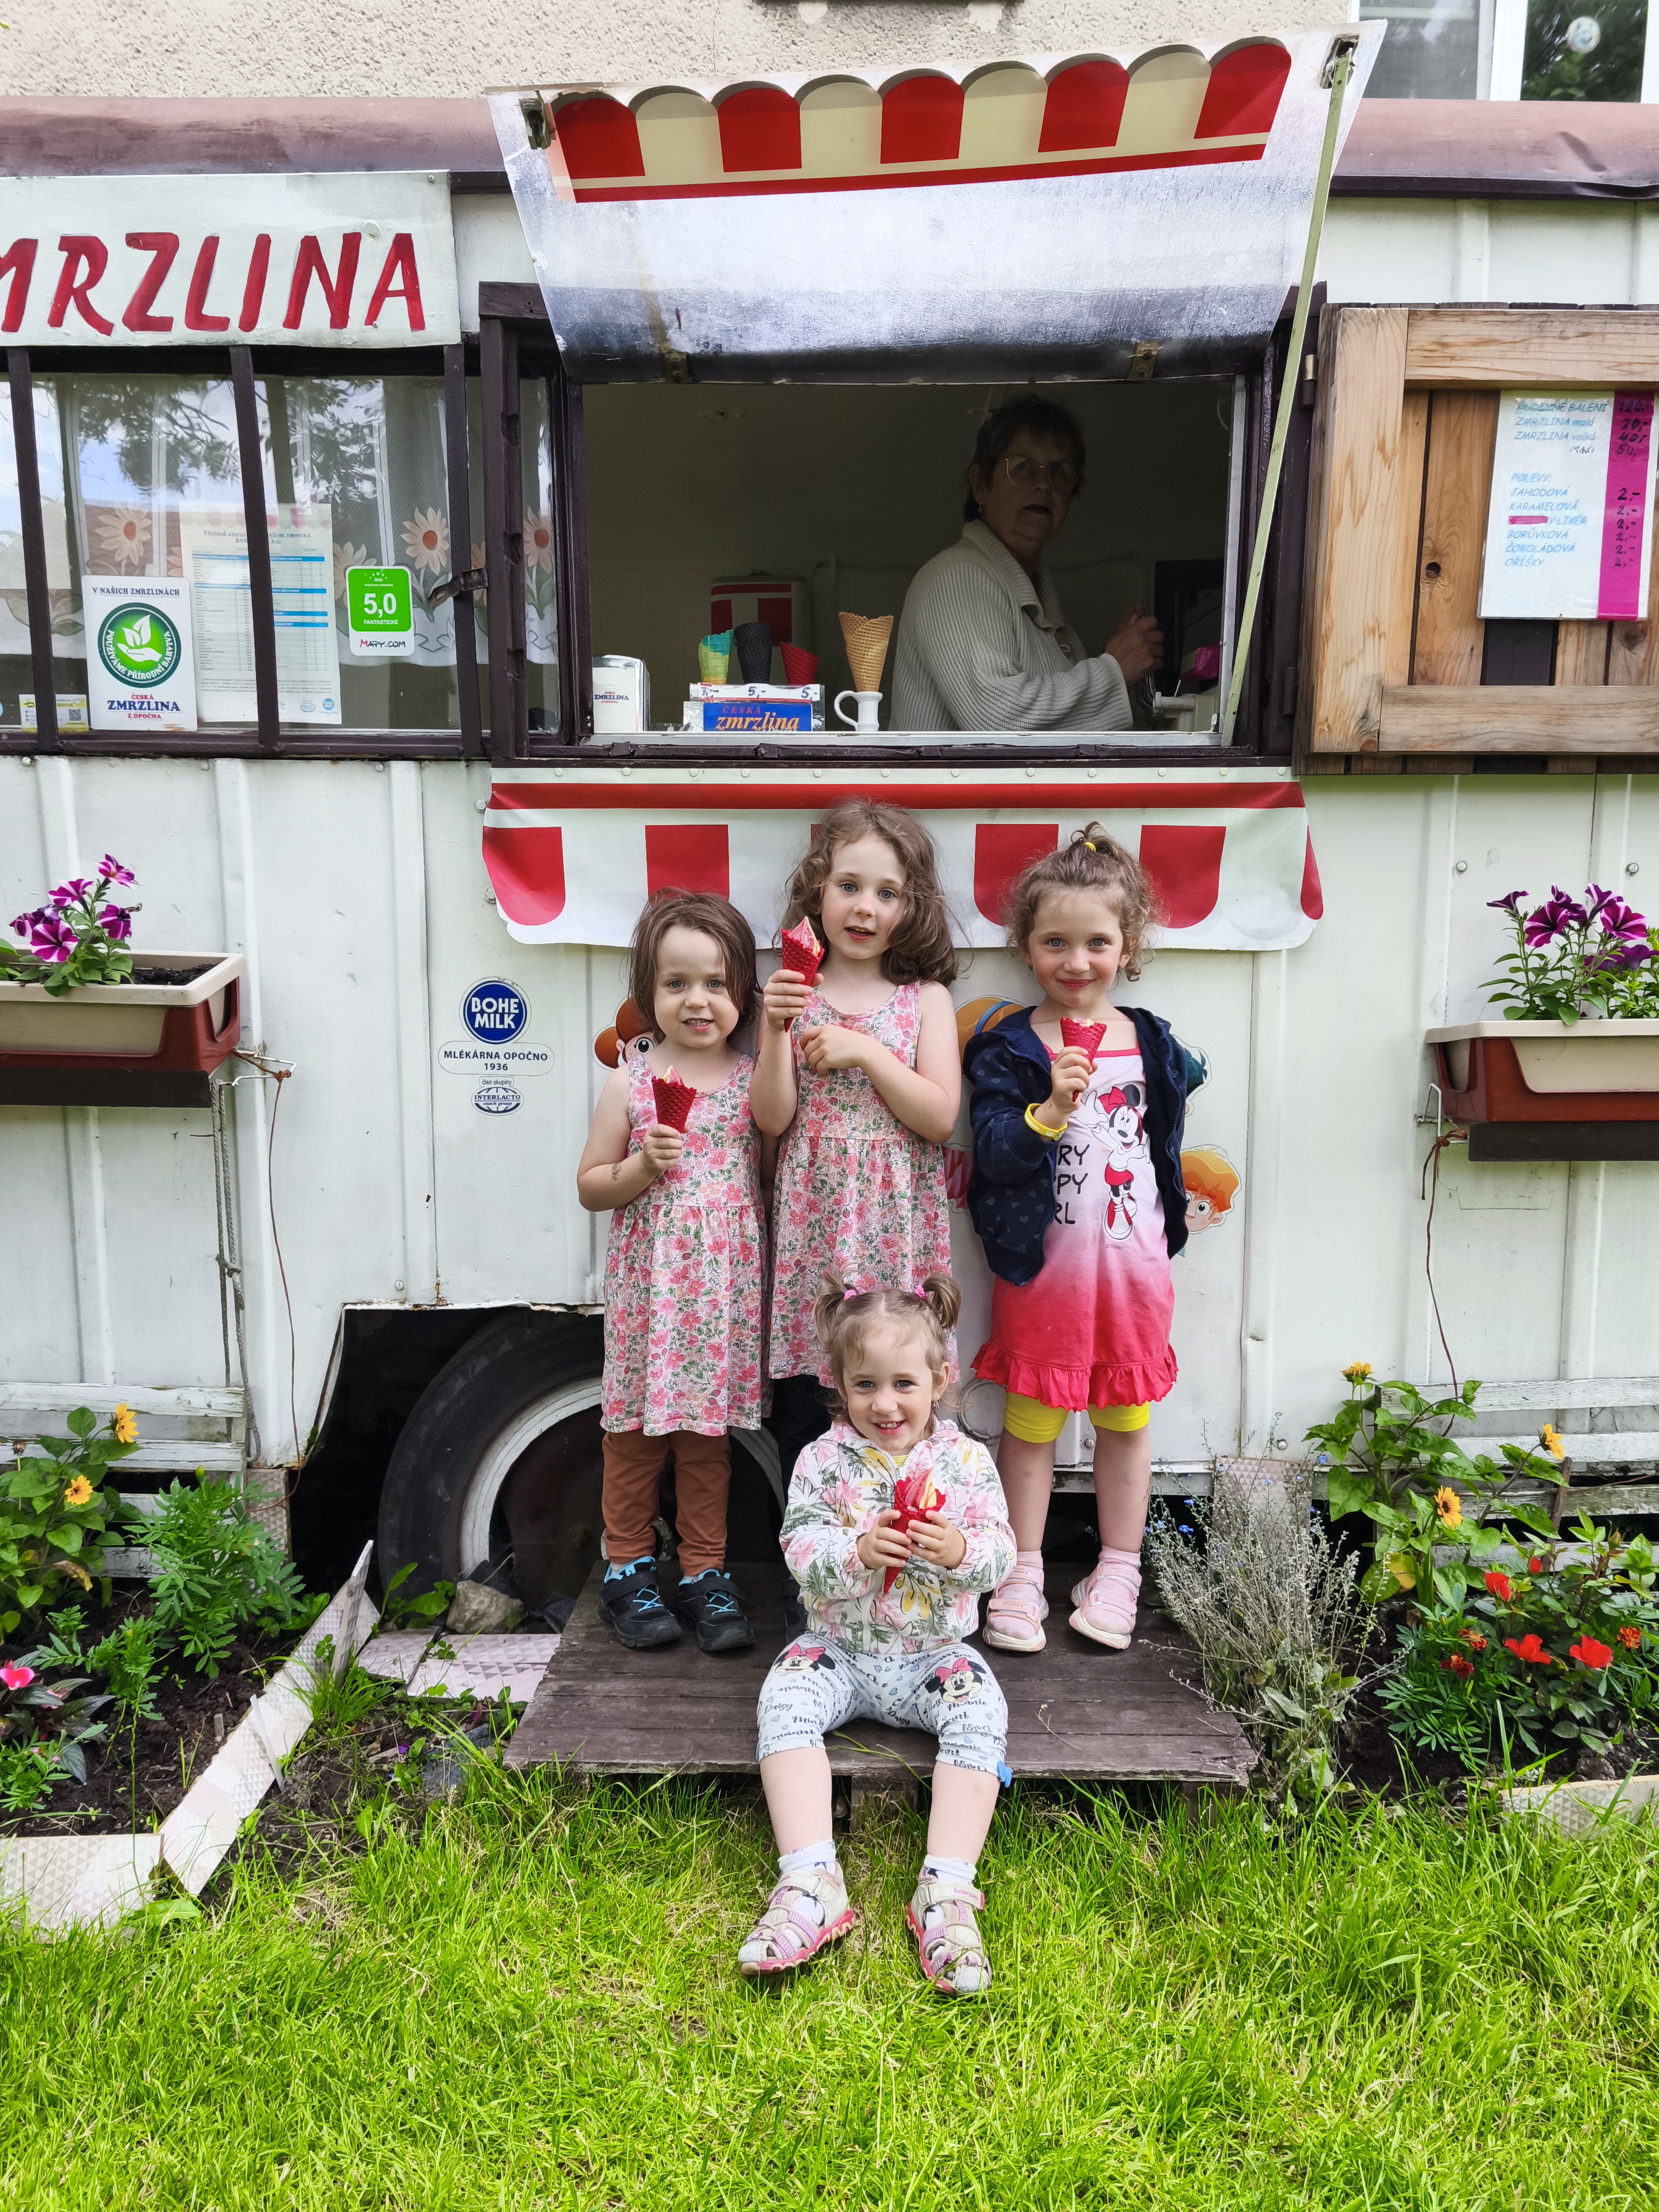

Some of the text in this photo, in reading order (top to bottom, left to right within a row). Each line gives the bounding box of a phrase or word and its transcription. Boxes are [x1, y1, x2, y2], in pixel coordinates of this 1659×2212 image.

[1515, 417, 1570, 426] ZMRZLINA
[1514, 431, 1569, 440] ZMRZLINA
[1510, 485, 1570, 497] JAHODOVÁ
[1617, 487, 1641, 502] 2,-
[1509, 499, 1580, 511] KARAMELOVÁ
[1507, 527, 1570, 539] BORŮVKOVÁ
[1505, 541, 1577, 554] ČOKOLÁDOVÁ
[100, 586, 129, 595] NAŠICH
[131, 586, 180, 596] ZMRZLINÁCH
[363, 593, 397, 618] 5,0
[163, 631, 174, 667] BARVIVA
[107, 700, 180, 711] ZMRZLINA
[721, 705, 761, 714] ČESKÁ
[715, 712, 799, 731] zmrzlina
[471, 997, 519, 1013] BOHE
[474, 1013, 516, 1029] MILK
[444, 1050, 548, 1061] MLÉKÁRNA OPOČNO
[1057, 1144, 1090, 1166] RY
[1054, 1172, 1088, 1195] PY
[1053, 1202, 1076, 1225] RL
[764, 1703, 793, 1714] Daisy
